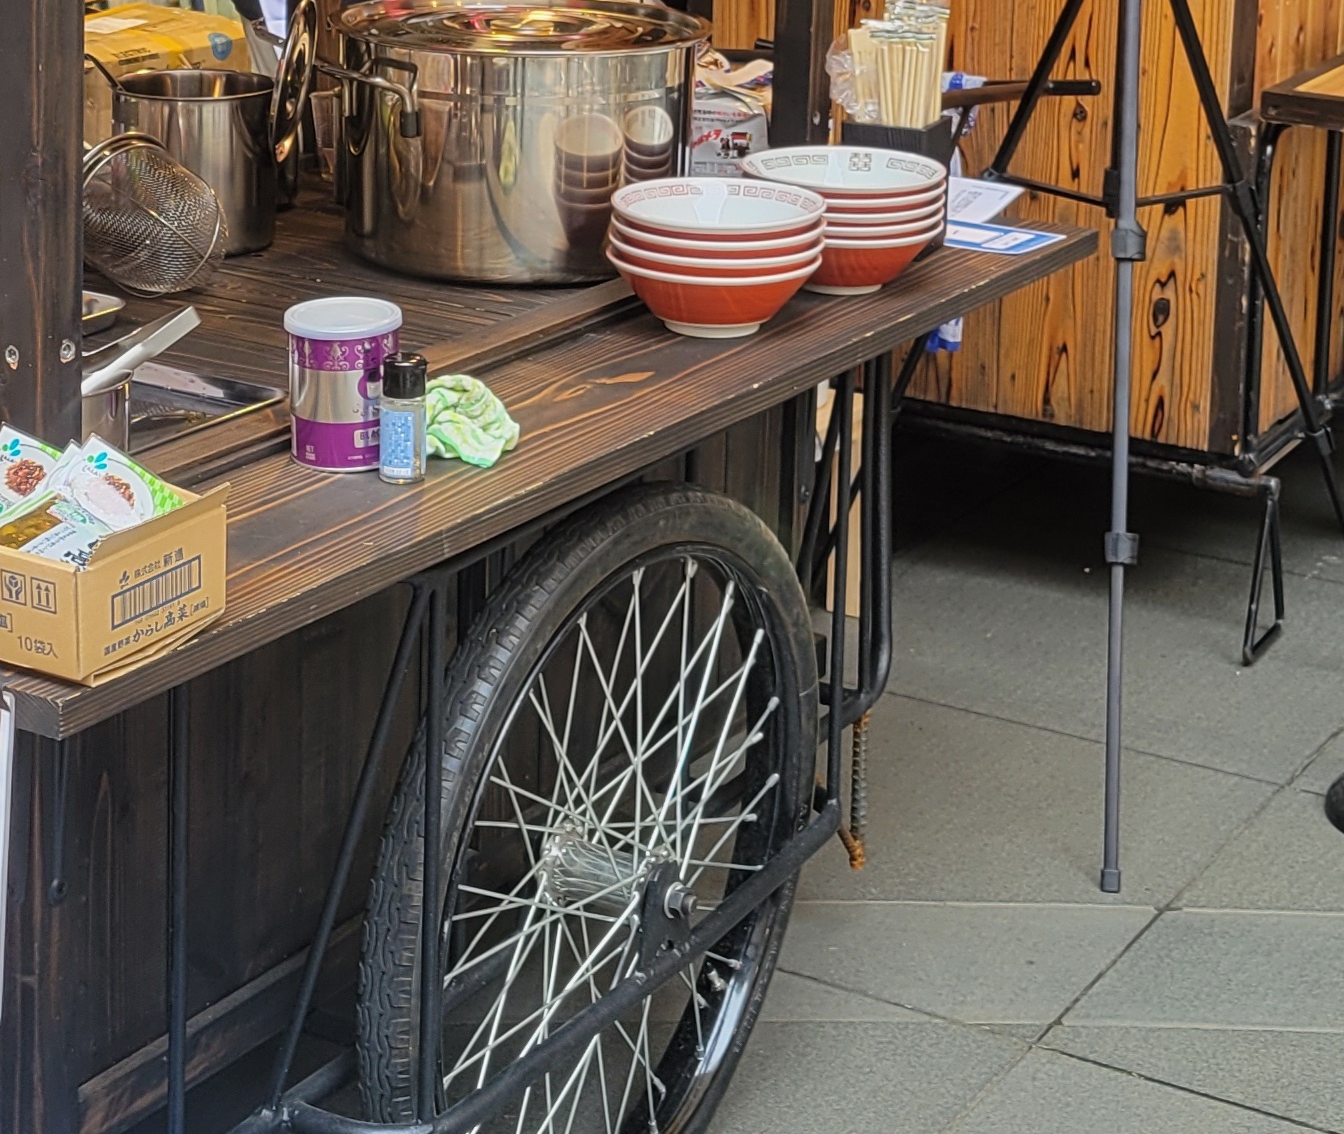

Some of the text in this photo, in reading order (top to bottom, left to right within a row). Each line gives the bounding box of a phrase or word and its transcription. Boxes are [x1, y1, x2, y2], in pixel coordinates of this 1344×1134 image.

[17, 635, 59, 659] 10袋入
[104, 637, 131, 656] 国産野菜
[132, 604, 190, 643] からし高菜
